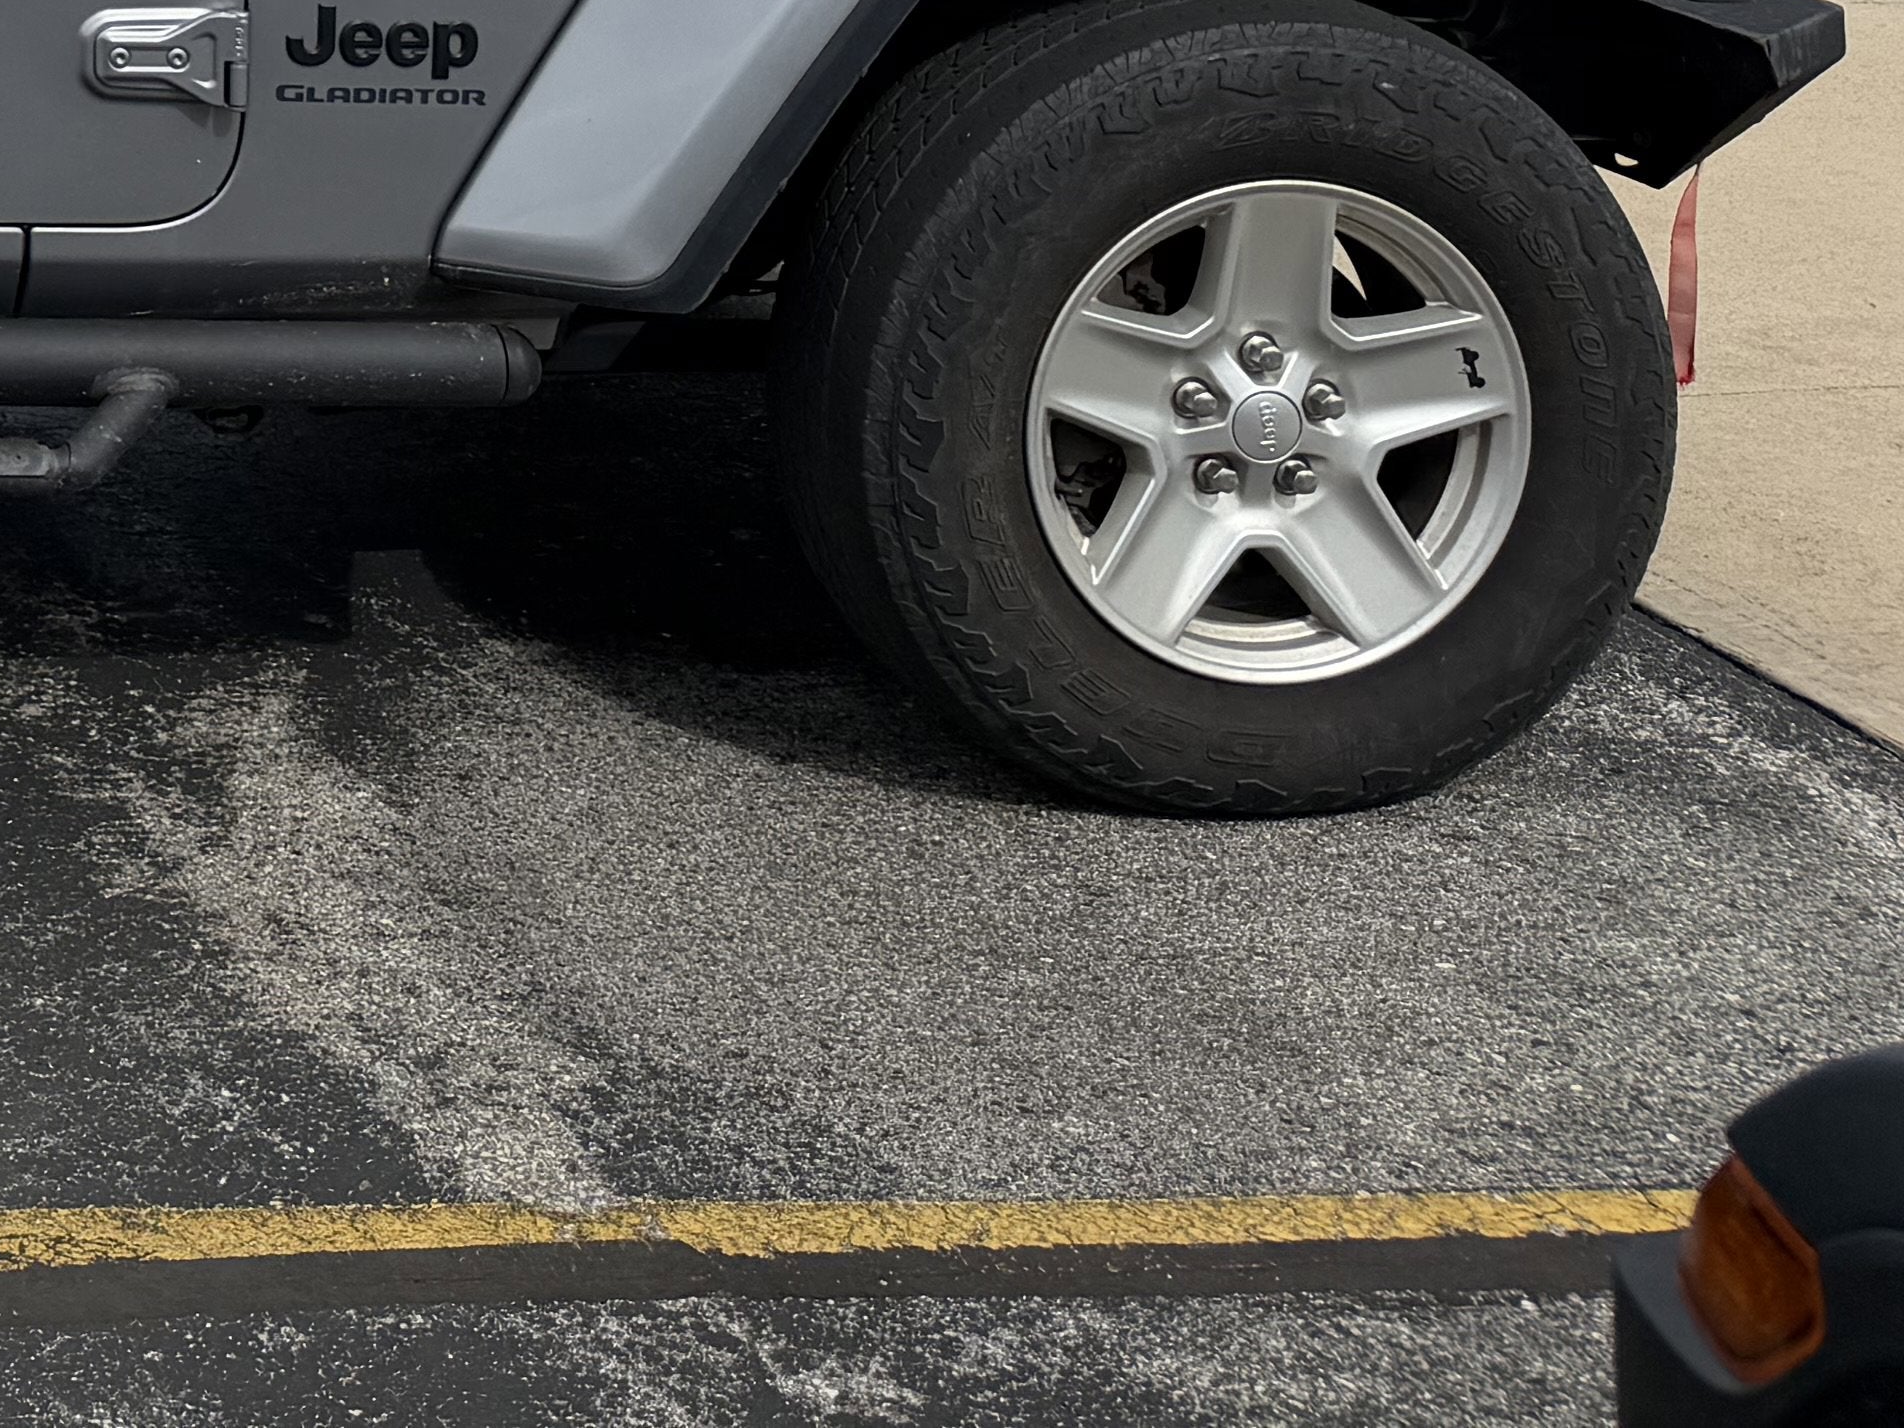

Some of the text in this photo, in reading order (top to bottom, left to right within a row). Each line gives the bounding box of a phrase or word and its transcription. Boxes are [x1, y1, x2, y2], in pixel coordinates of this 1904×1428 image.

[285, 3, 480, 80] Jeep
[275, 84, 487, 106] GLADIATOR
[1258, 401, 1278, 452] Jeep
